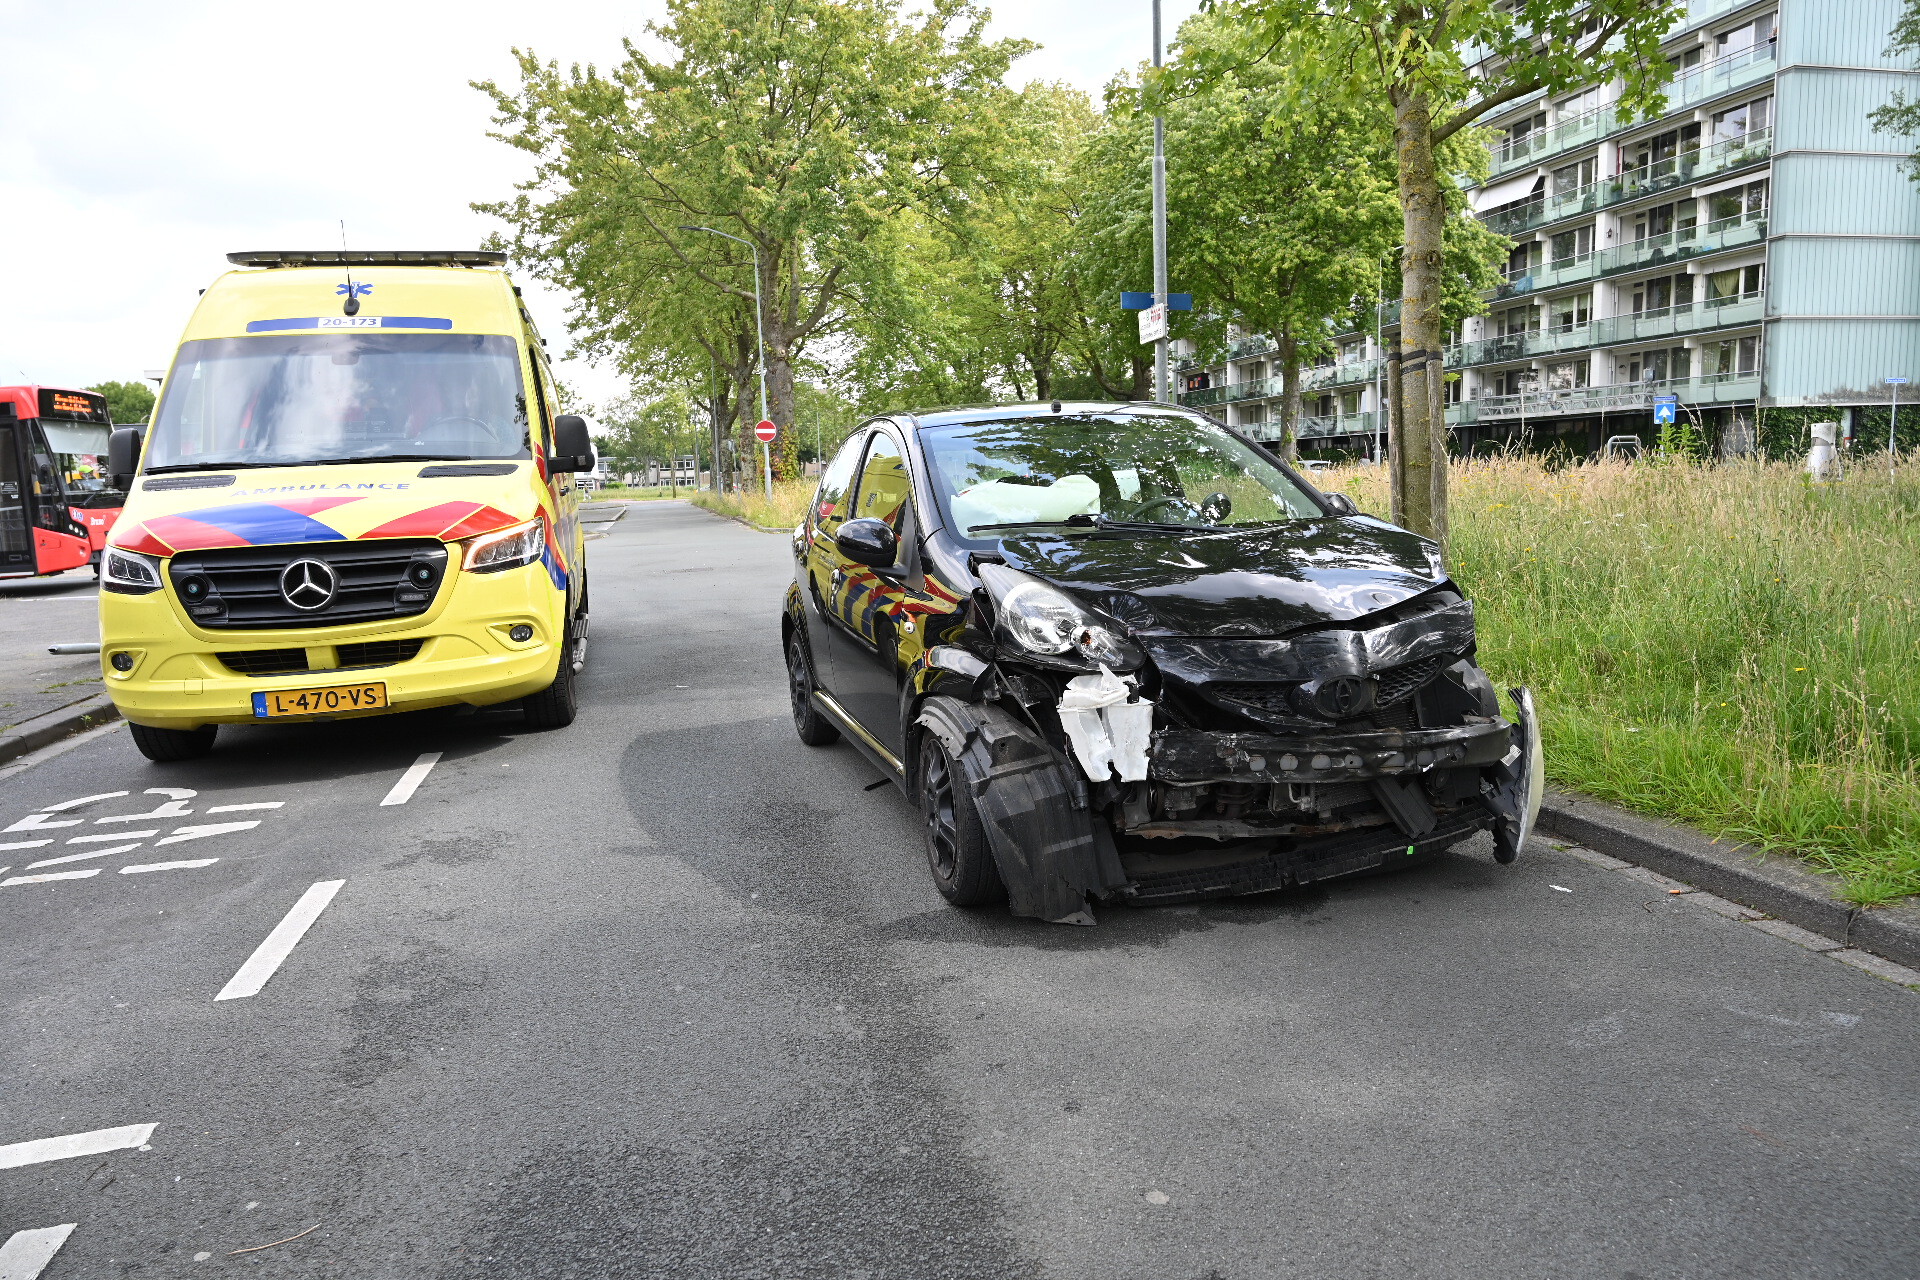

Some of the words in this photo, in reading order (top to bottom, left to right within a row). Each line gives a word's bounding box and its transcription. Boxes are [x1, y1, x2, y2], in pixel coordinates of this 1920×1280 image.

[322, 318, 377, 326] 20-173
[230, 483, 411, 497] AMBULANCE
[275, 687, 377, 712] L-470-VS
